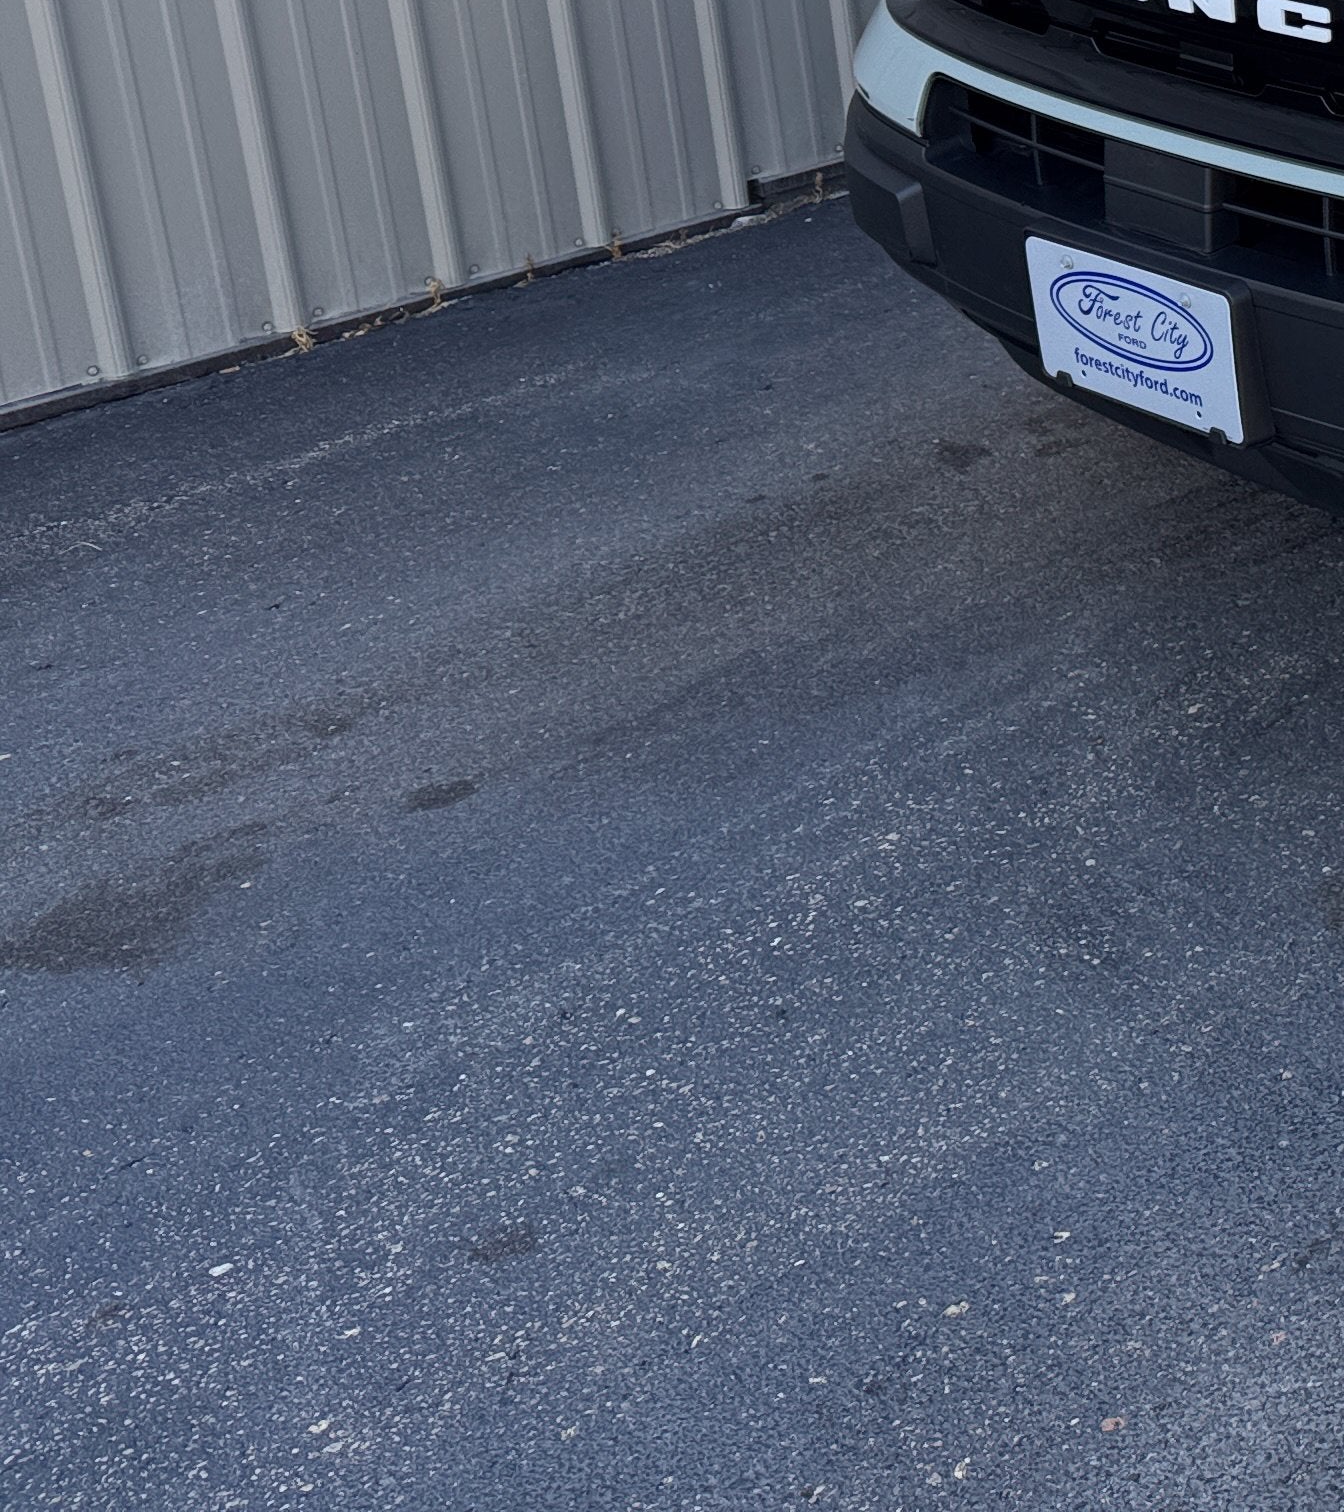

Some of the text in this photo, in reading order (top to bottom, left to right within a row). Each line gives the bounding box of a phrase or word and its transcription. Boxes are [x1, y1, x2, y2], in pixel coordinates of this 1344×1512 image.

[1078, 284, 1189, 359] Forest City
[1117, 332, 1147, 350] FORD
[1074, 347, 1203, 407] forestcityford.com
